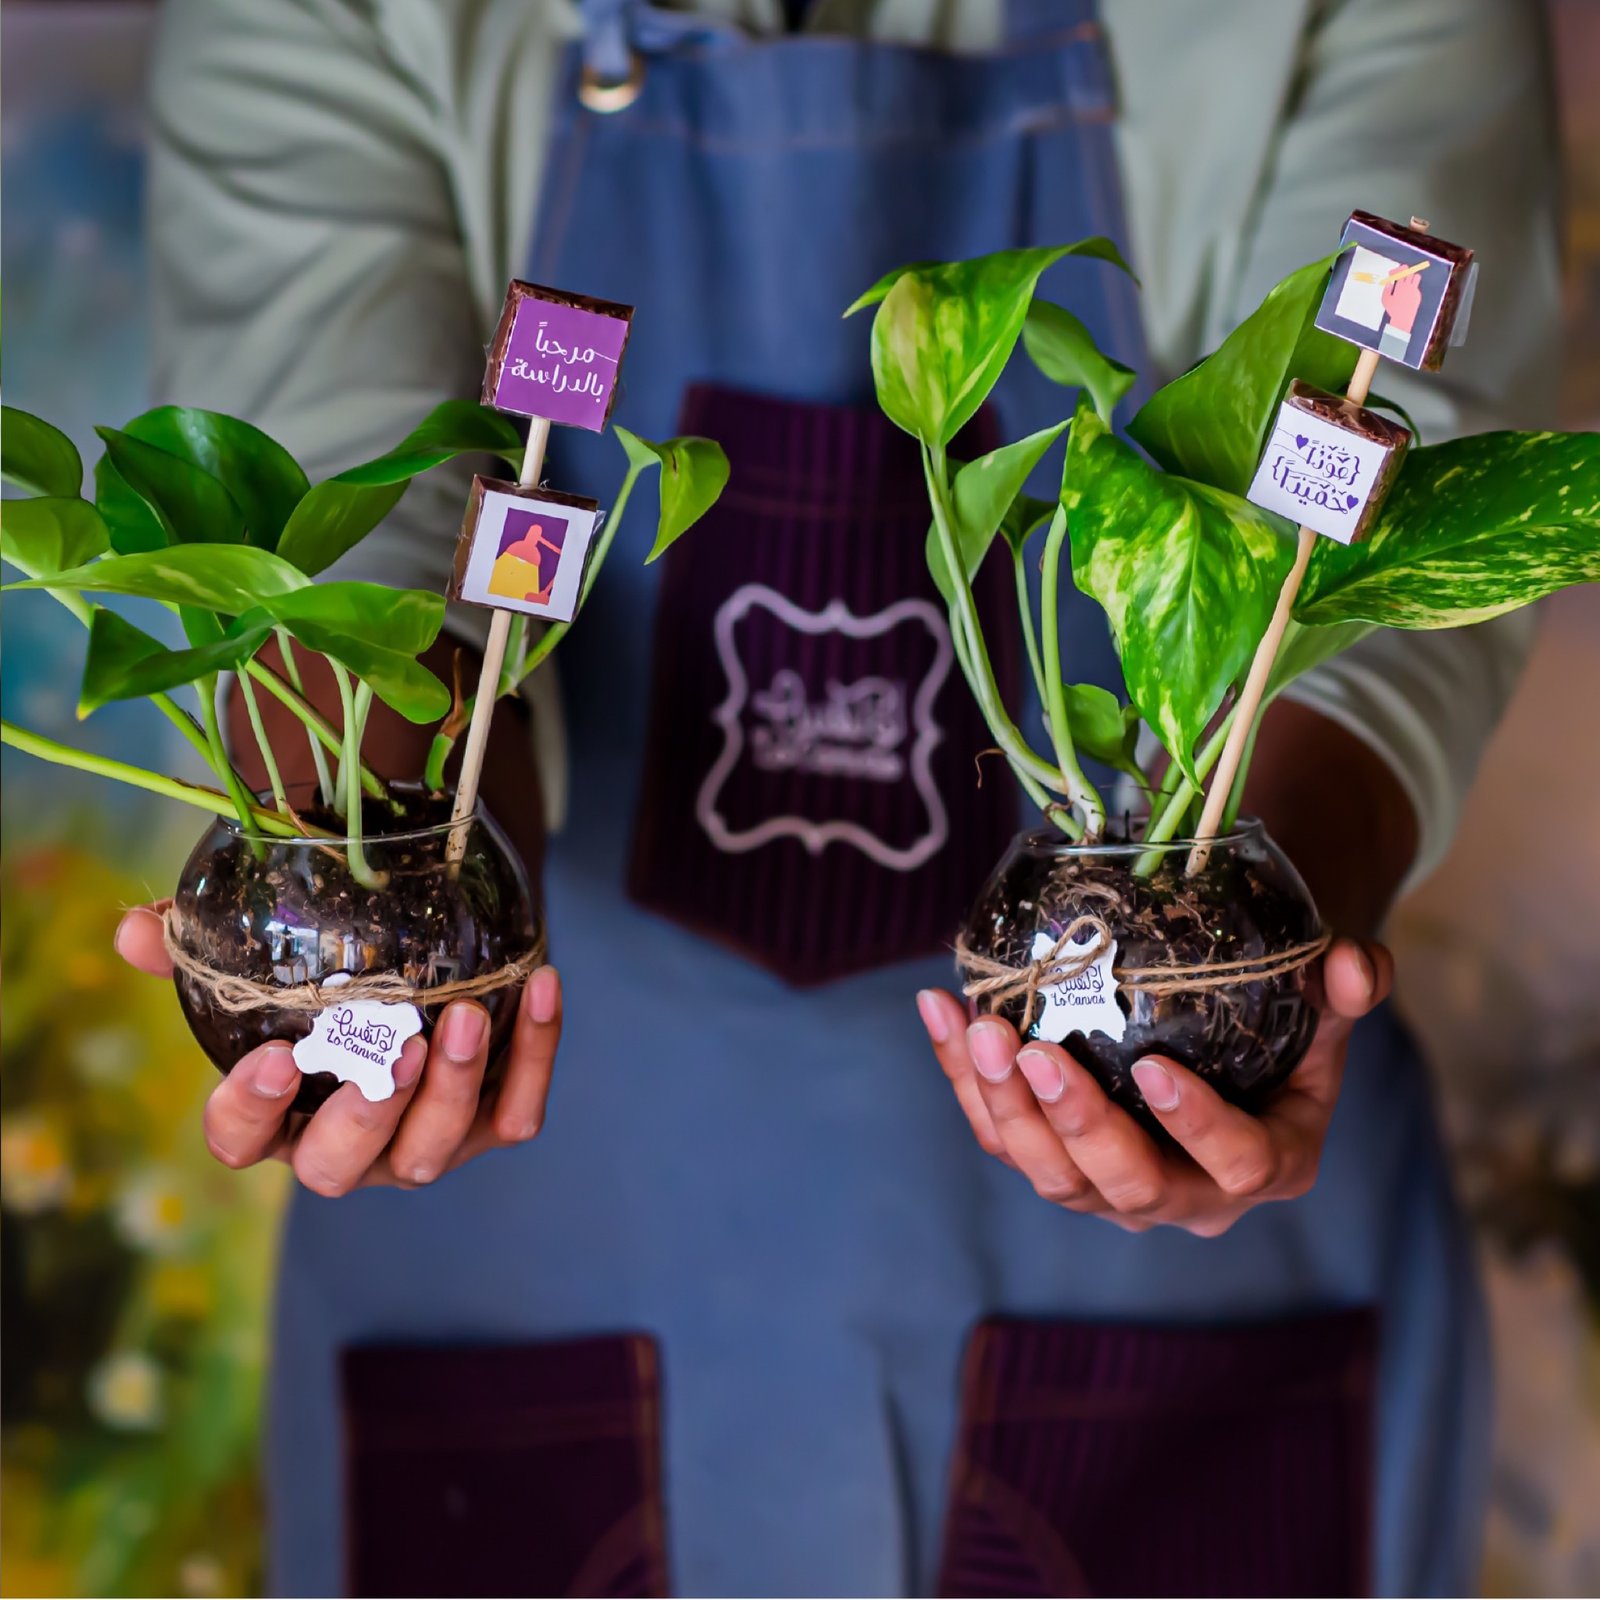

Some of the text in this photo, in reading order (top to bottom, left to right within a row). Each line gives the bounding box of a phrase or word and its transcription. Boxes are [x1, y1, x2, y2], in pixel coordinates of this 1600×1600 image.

[508, 358, 604, 403] بالدراسة
[1068, 993, 1106, 1006] Canvas
[343, 1038, 387, 1066] Canvas
